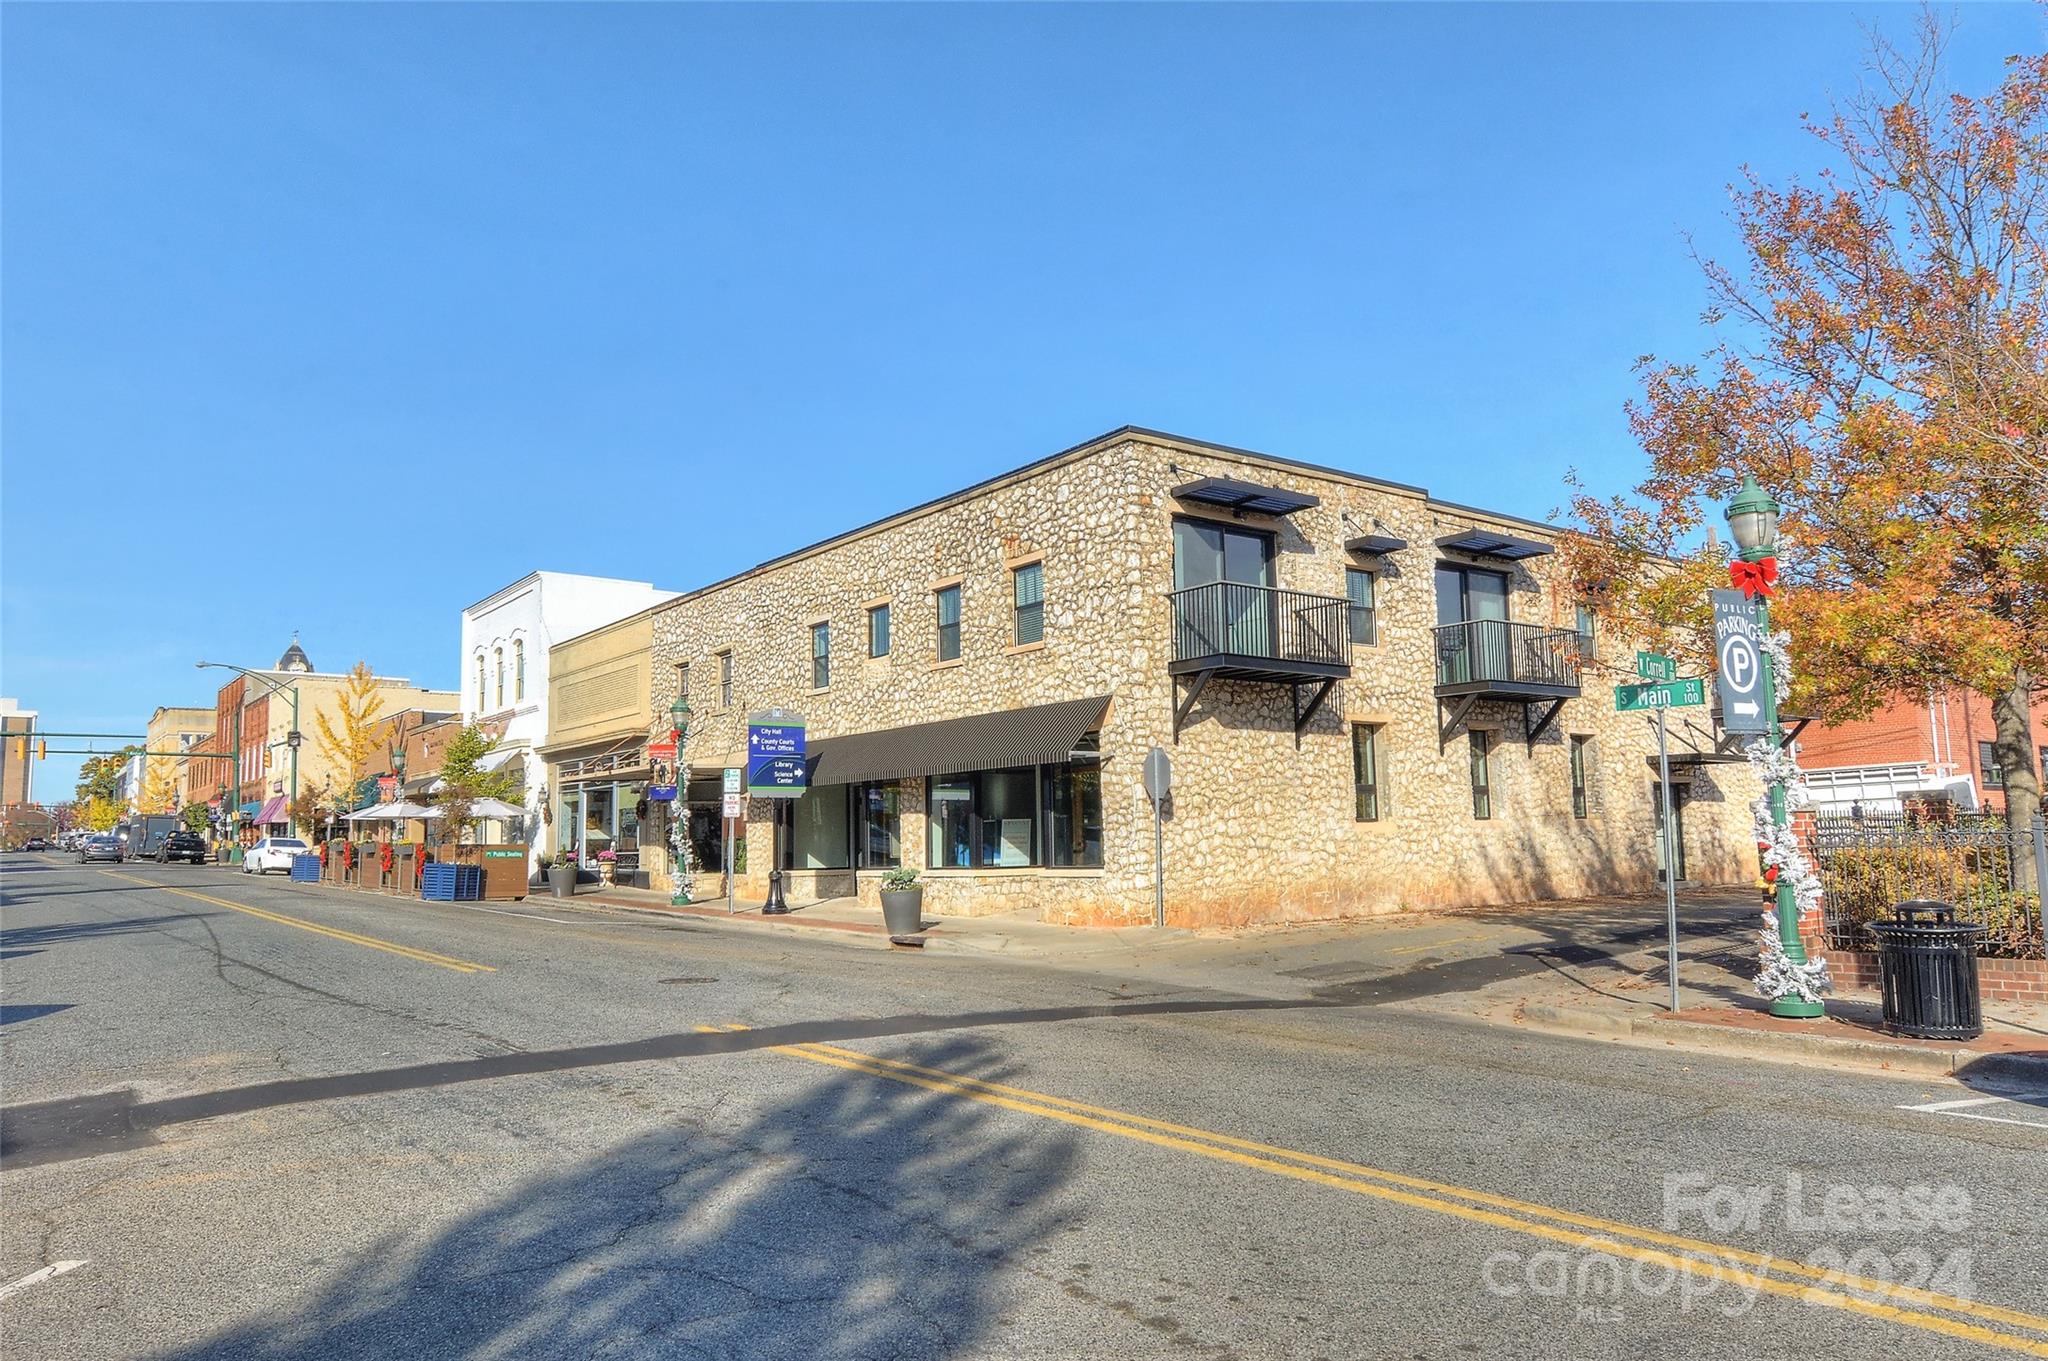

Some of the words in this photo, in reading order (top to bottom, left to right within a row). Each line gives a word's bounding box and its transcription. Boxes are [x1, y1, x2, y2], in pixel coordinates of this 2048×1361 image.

[1714, 603, 1756, 614] PUBLIC
[1717, 615, 1758, 641] PARKING
[1646, 656, 1666, 678] Correll
[1733, 647, 1749, 682] P
[1621, 692, 1627, 704] S
[1638, 686, 1671, 706] Main
[1685, 682, 1695, 692] St
[1684, 693, 1699, 703] 100
[774, 761, 793, 769] Library
